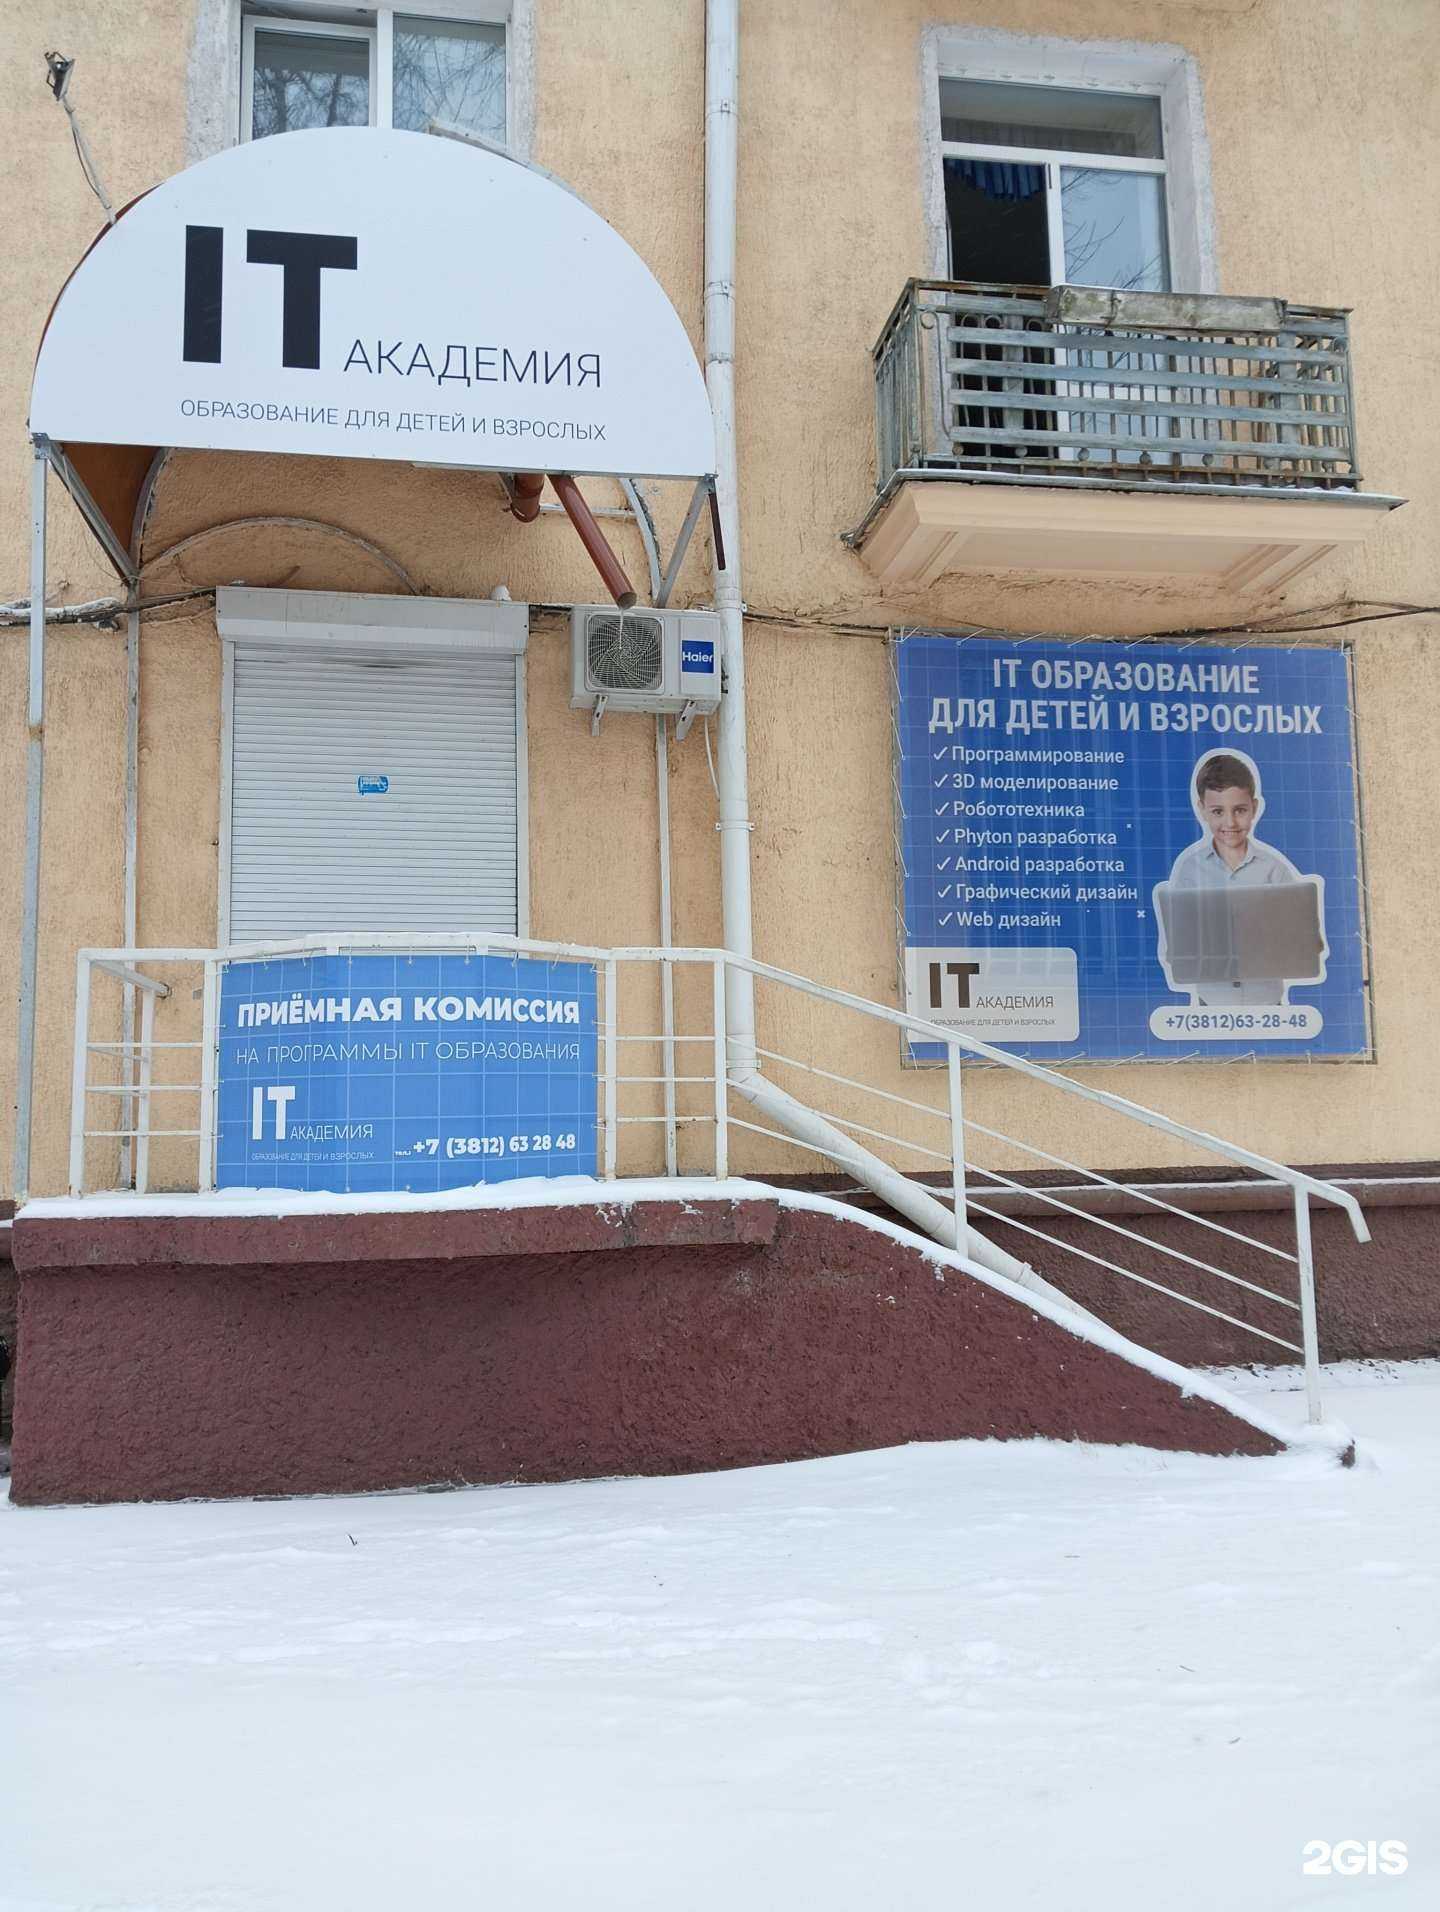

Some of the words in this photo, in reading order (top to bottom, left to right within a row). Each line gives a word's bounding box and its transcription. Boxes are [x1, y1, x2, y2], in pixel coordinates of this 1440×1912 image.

[182, 224, 358, 370] IT
[343, 338, 602, 388] АКАДЕМИЯ
[181, 399, 340, 427] ОБРАЗОВАНИЕ
[344, 408, 390, 431] ДЛЯ
[395, 410, 466, 434] ДЕТЕЙ
[472, 415, 487, 434] И
[492, 417, 607, 442] ВЗРОСЛЫХ
[682, 651, 713, 663] Haier
[993, 658, 1022, 688] IT
[1031, 659, 1261, 695] ОБРАЗОВАНИЕ
[929, 698, 996, 734] ДЛЯ
[1006, 695, 1110, 735] ДЕТЕЙ
[1118, 704, 1140, 731] И
[1150, 702, 1323, 735] ВЗРОСЛЫХ
[952, 746, 1125, 766] Программирование
[952, 773, 975, 789] 3D
[980, 776, 1119, 793] моделирование
[953, 800, 1086, 817] Робототехника
[954, 829, 1013, 848] Phyton
[1017, 830, 1118, 848] разработка
[955, 856, 1020, 872] Android
[1025, 857, 1125, 875] разработка
[956, 883, 1071, 902] Графический
[1075, 884, 1138, 902] дизайн
[956, 911, 994, 927] Web
[998, 911, 1061, 929] дизайн
[929, 963, 980, 1009] IT
[238, 993, 402, 1027] ПРИЁМНАЯ
[414, 996, 580, 1025] КОМИССИЯ
[976, 995, 1054, 1011] АКАДЕМИЯ
[1166, 1013, 1308, 1031] +7(3812)63-28-48
[236, 1047, 260, 1065] НА
[267, 1042, 402, 1064] ПРОГРАММЫ
[411, 1041, 429, 1060] IT
[435, 1041, 580, 1061] ОБРАЗОВАНИЯ
[252, 1085, 296, 1140] IT
[290, 1123, 373, 1142] АКАДЕМИЯ
[330, 1151, 375, 1161] ВЗРОСЛЫХ
[413, 1138, 440, 1155] +7
[446, 1136, 505, 1158] (3812)
[509, 1135, 529, 1152] 63
[532, 1134, 552, 1151] 28
[555, 1134, 576, 1150] 48
